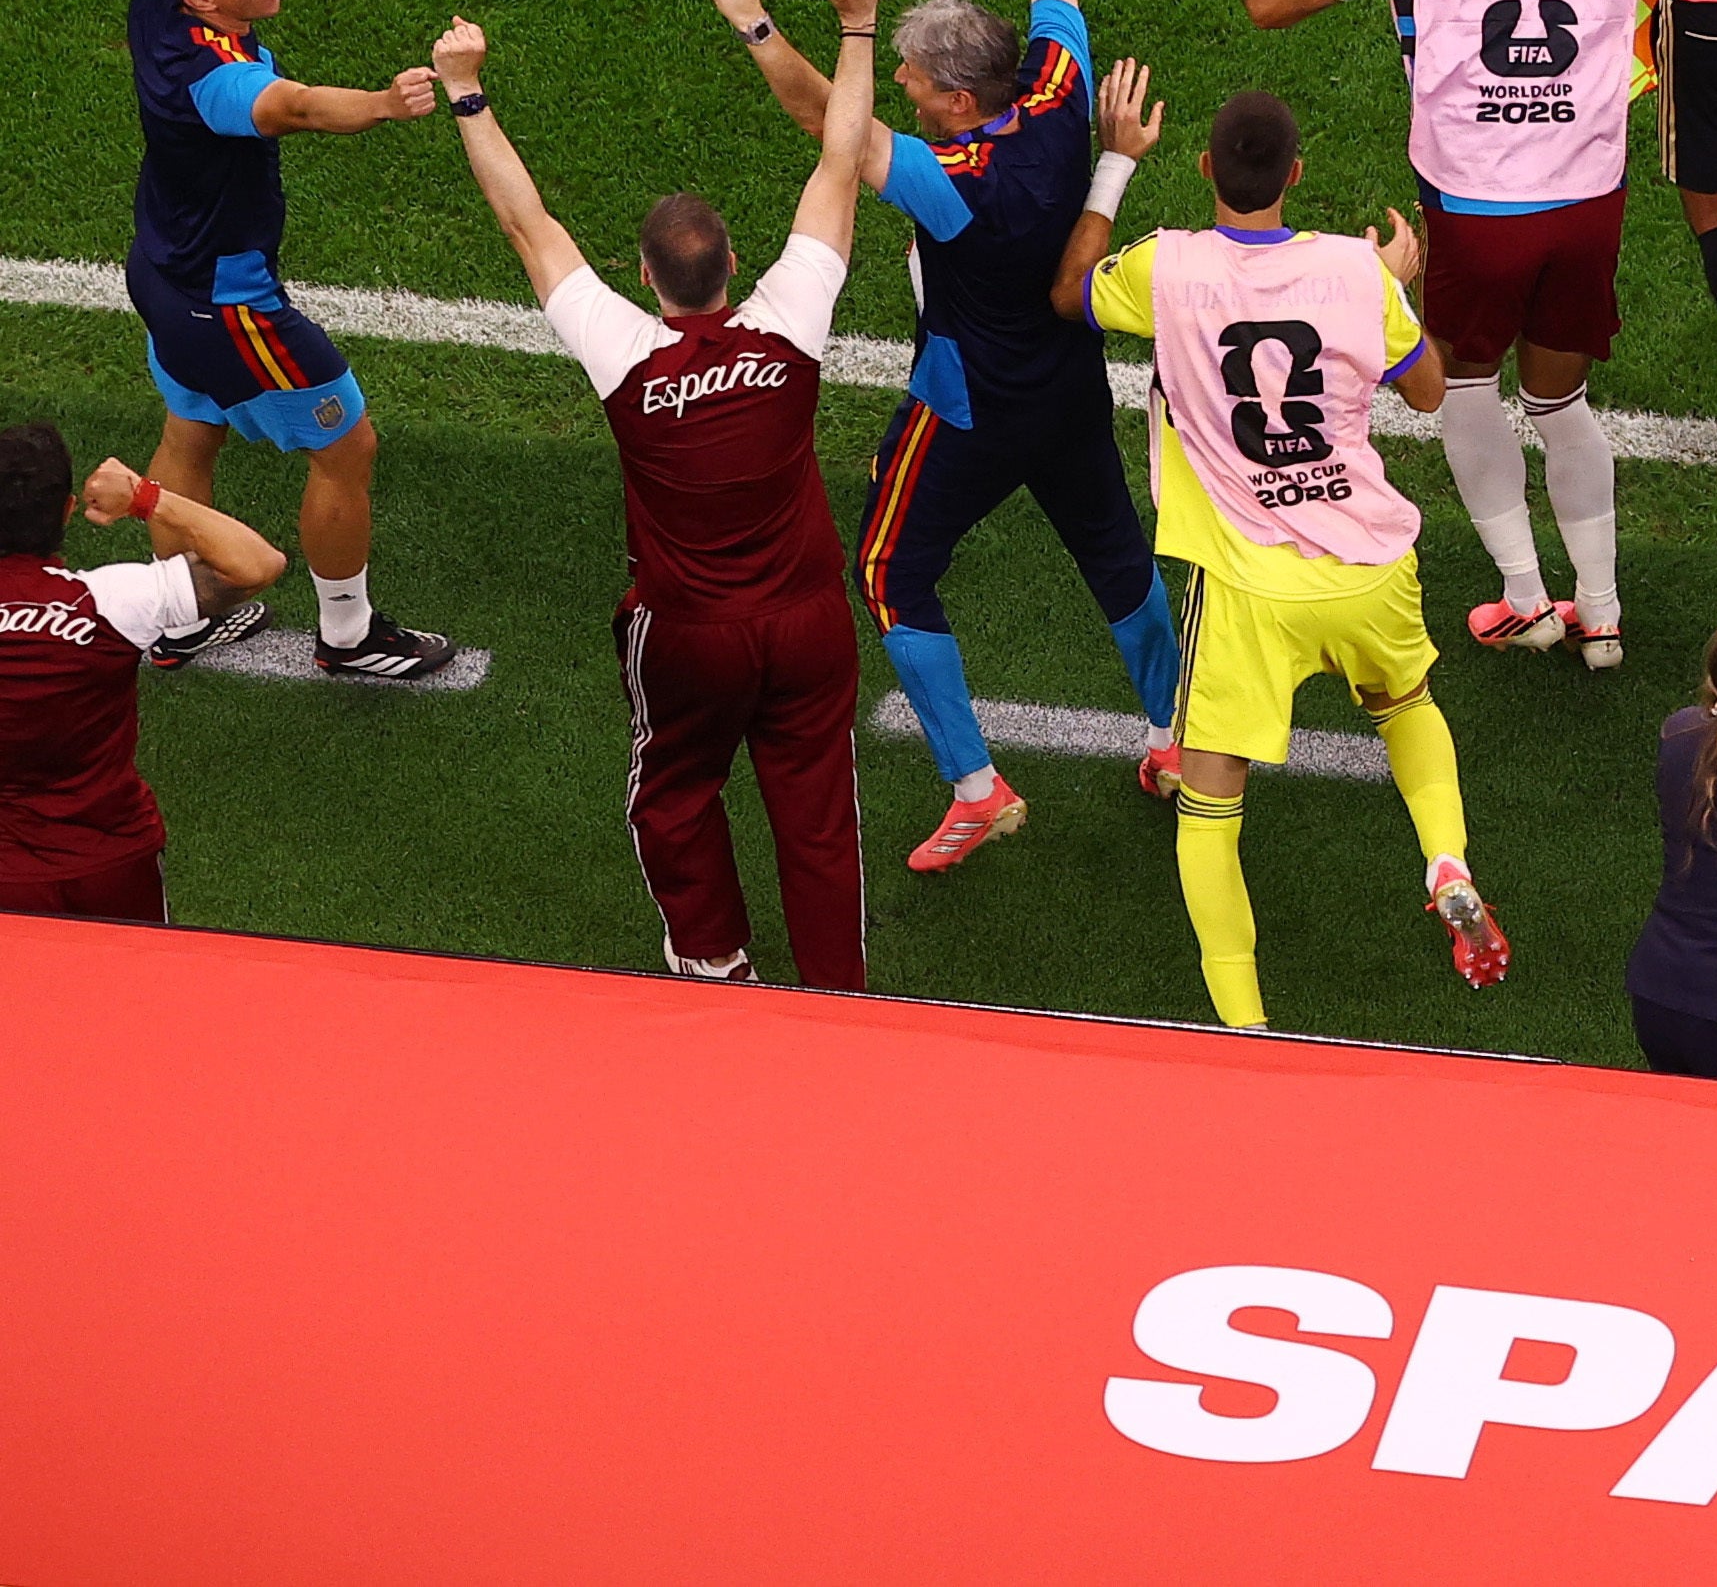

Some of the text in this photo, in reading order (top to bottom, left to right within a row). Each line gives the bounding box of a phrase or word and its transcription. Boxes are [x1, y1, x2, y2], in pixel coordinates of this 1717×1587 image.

[1508, 45, 1553, 64] FIFA
[1479, 84, 1573, 100] WORLD CUP
[1475, 100, 1576, 124] 2026
[642, 352, 788, 419] España
[1264, 436, 1313, 456] FIFA
[1311, 463, 1347, 481] CUP
[1255, 478, 1352, 510] 2026
[0, 601, 97, 646] aña
